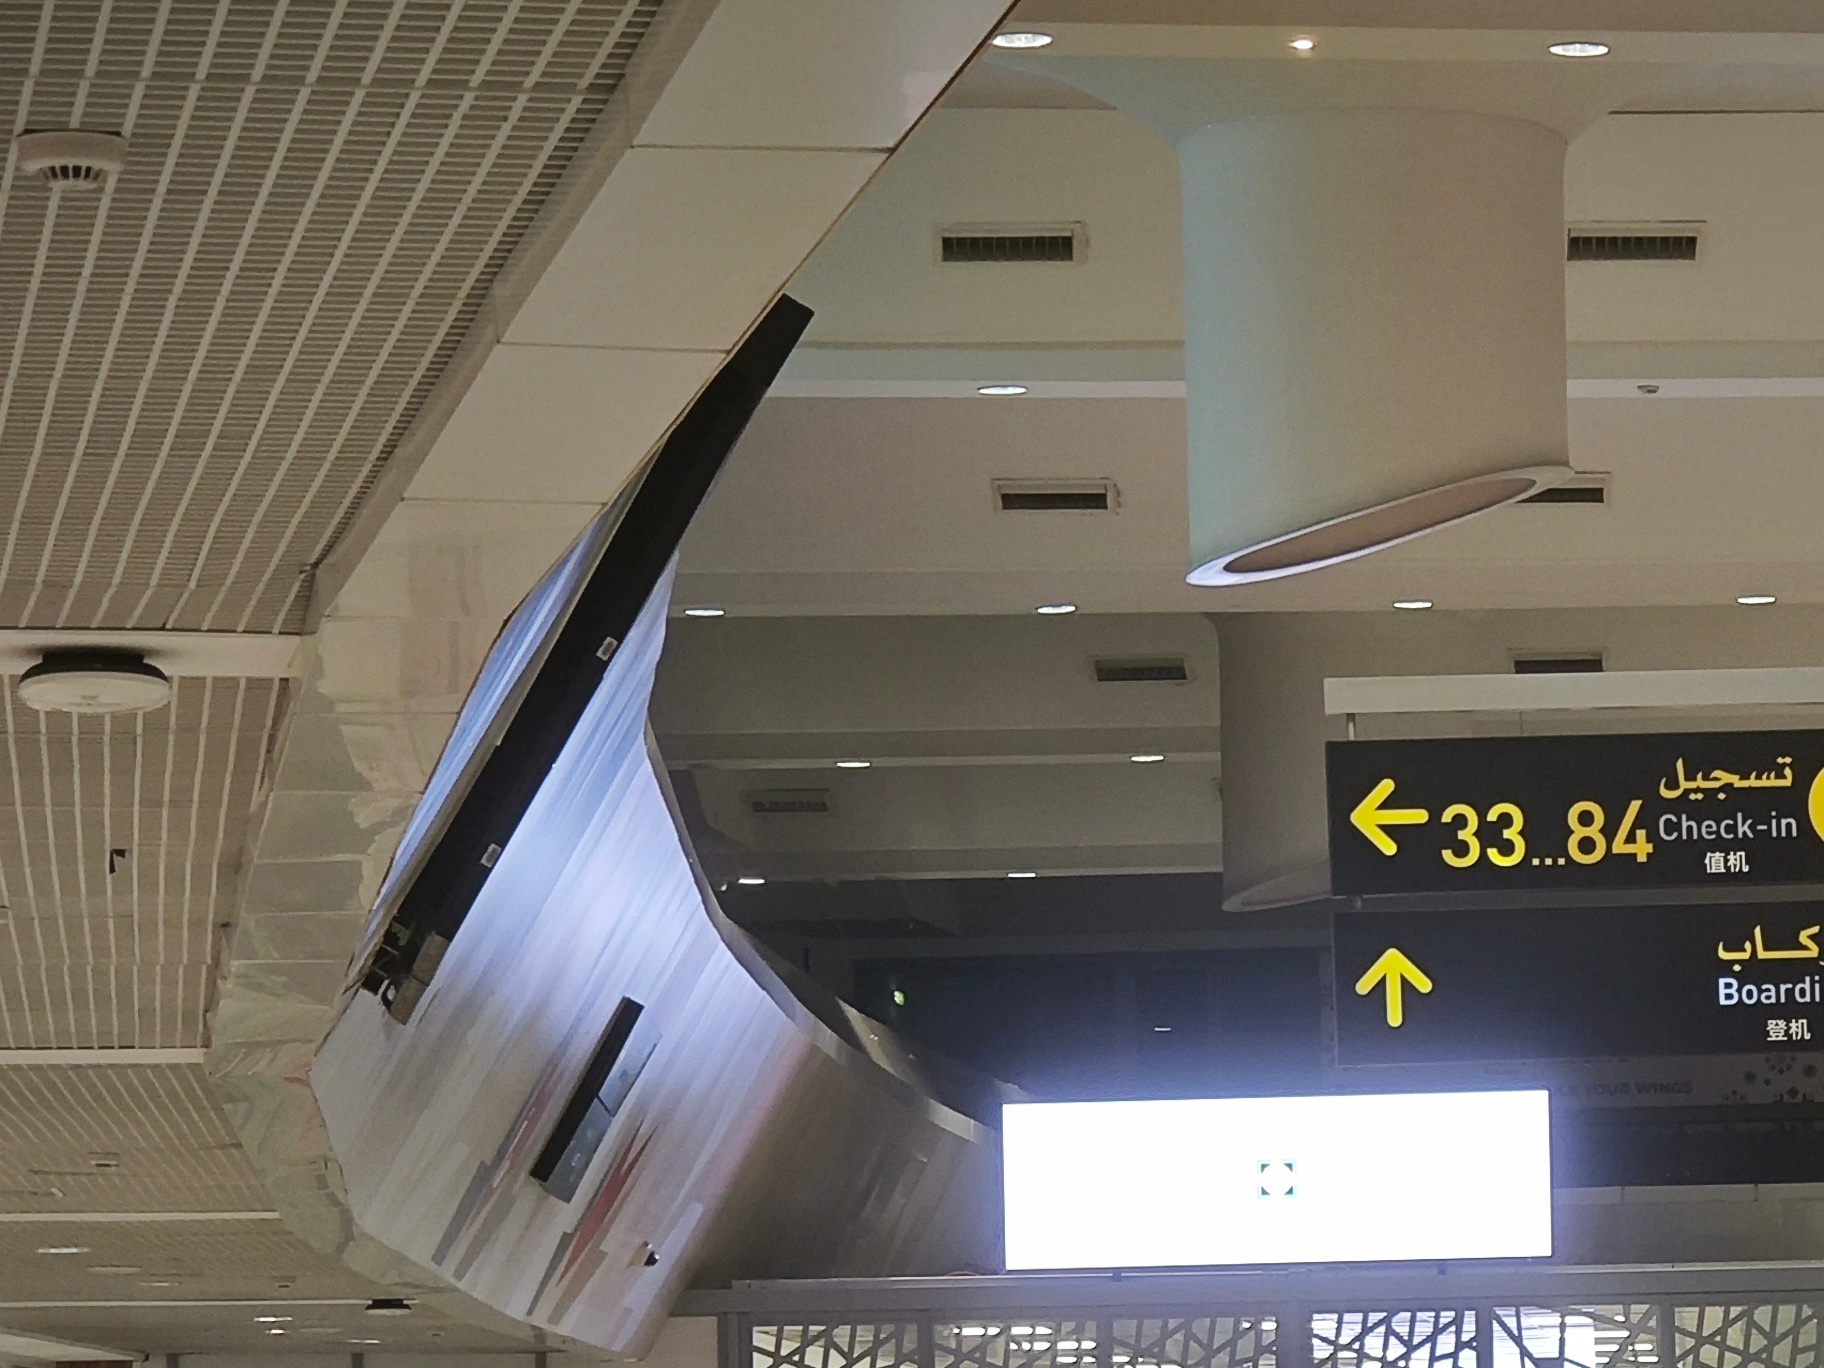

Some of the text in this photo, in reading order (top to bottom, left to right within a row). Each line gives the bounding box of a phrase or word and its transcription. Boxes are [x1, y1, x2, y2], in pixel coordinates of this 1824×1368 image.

[1660, 757, 1792, 800] تسجيل
[1659, 811, 1797, 840] Check-in
[1705, 852, 1749, 873] 值机
[1767, 1019, 1810, 1040] 登机
